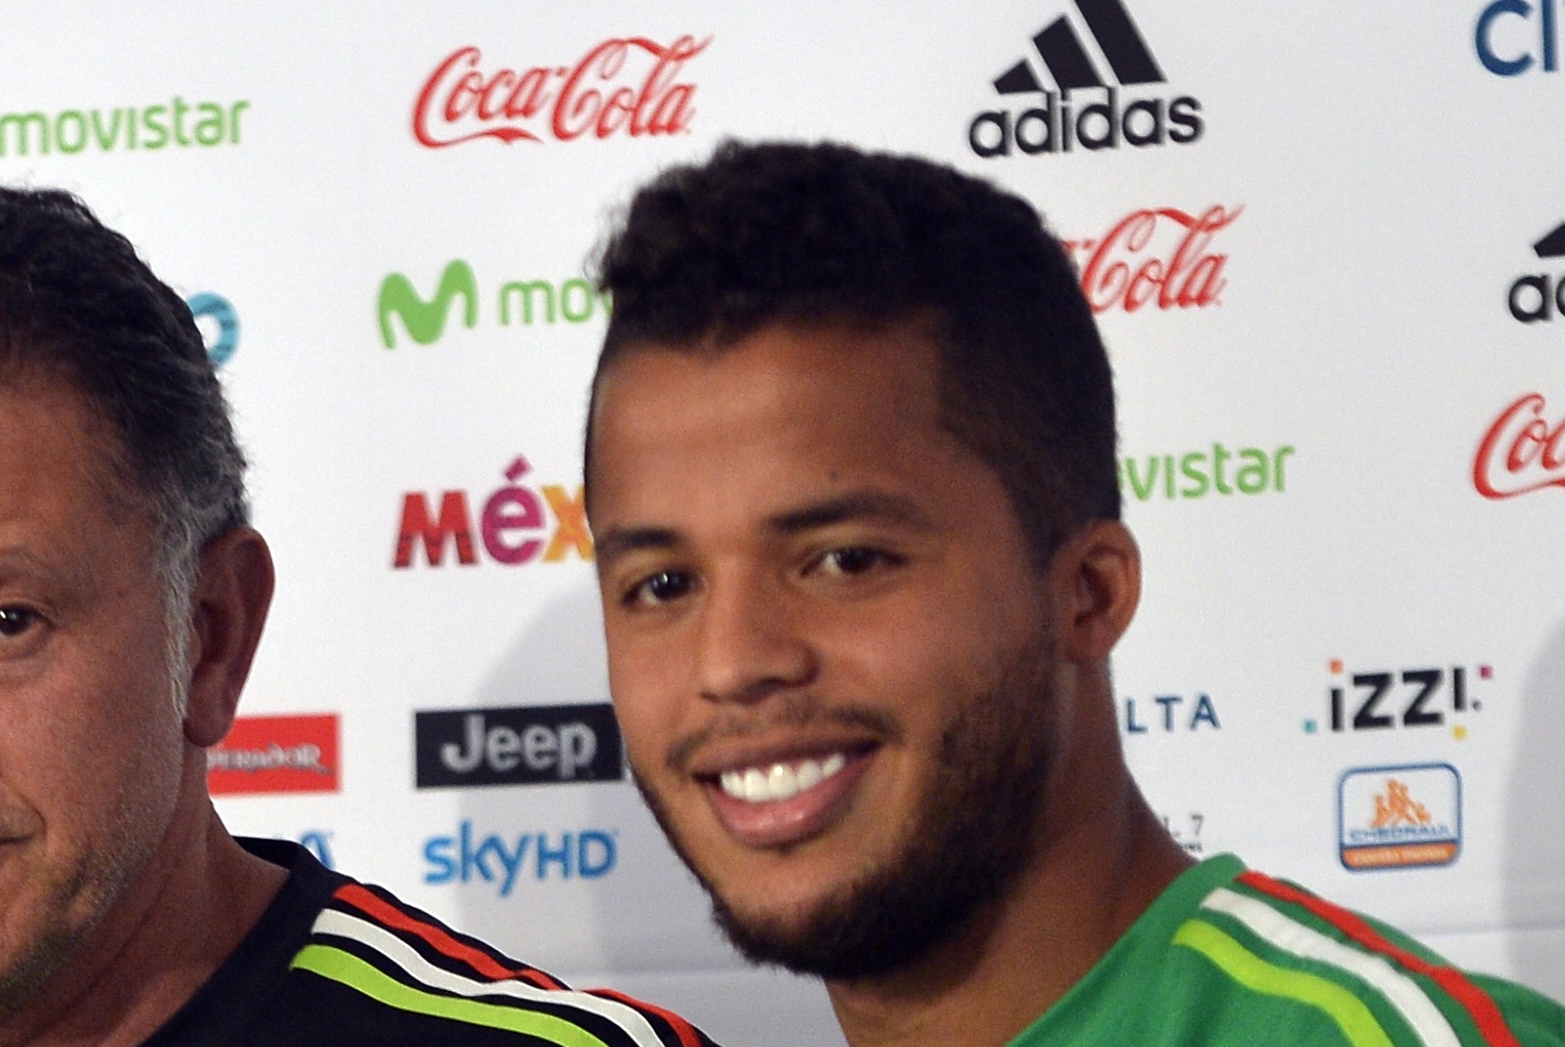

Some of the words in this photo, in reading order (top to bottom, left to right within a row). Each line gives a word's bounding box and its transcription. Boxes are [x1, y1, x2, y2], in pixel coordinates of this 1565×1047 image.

[412, 34, 714, 149] Coca-Cola
[968, 85, 1204, 159] adidas
[1122, 443, 1297, 501] vistar
[1126, 693, 1222, 734] LTA
[442, 714, 598, 777] Jeep
